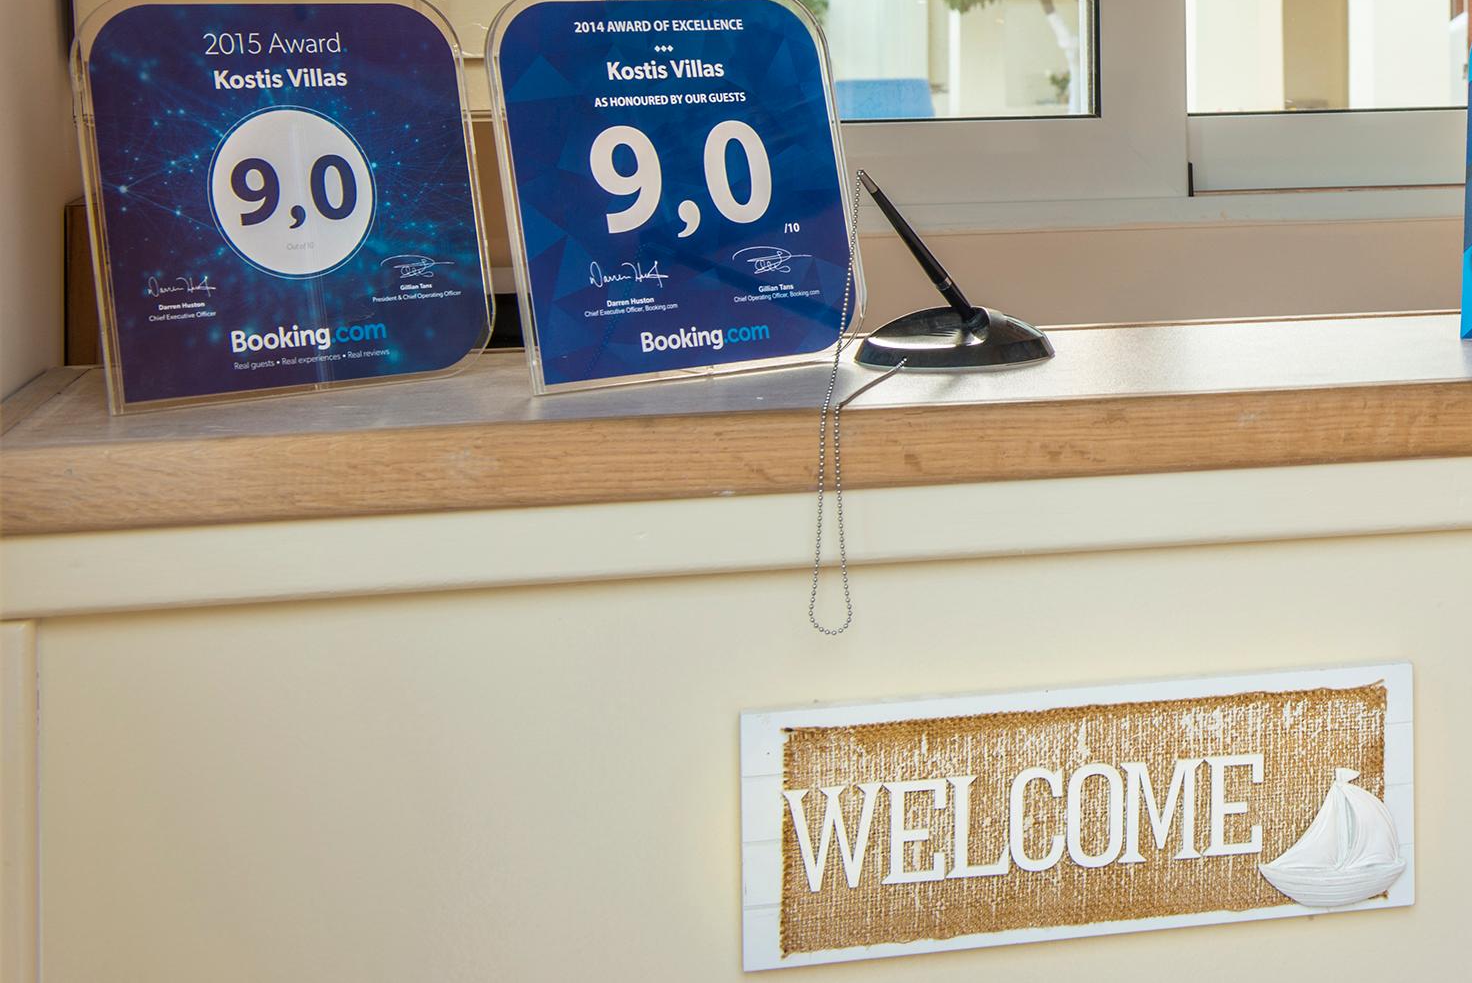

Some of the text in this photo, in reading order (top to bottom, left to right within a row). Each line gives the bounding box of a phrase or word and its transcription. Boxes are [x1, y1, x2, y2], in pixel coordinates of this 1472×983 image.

[574, 19, 743, 33] 2014 AWARD OF EXCELLENCE
[203, 32, 342, 56] 2015 Award
[213, 67, 348, 90] Kostis Villas
[607, 59, 724, 80] Kostis Villas
[595, 92, 746, 107] AS HONOURED BY OUR GUESTS
[589, 120, 773, 238] 9,0
[230, 154, 357, 229] 9,0
[784, 223, 800, 233] /10
[417, 291, 443, 299] Operating
[607, 297, 654, 307] Darren Huston
[748, 293, 771, 302] Operating
[790, 289, 820, 297] Booking.com
[148, 310, 216, 322] Chief Executive Officer
[600, 308, 625, 316] Executive
[645, 303, 678, 311] Booking.com
[230, 323, 387, 352] Booking.com
[641, 323, 770, 353] Booking.com
[234, 348, 390, 370] Real guests Real experiences Real reviews
[785, 753, 1264, 892] WELCOME
